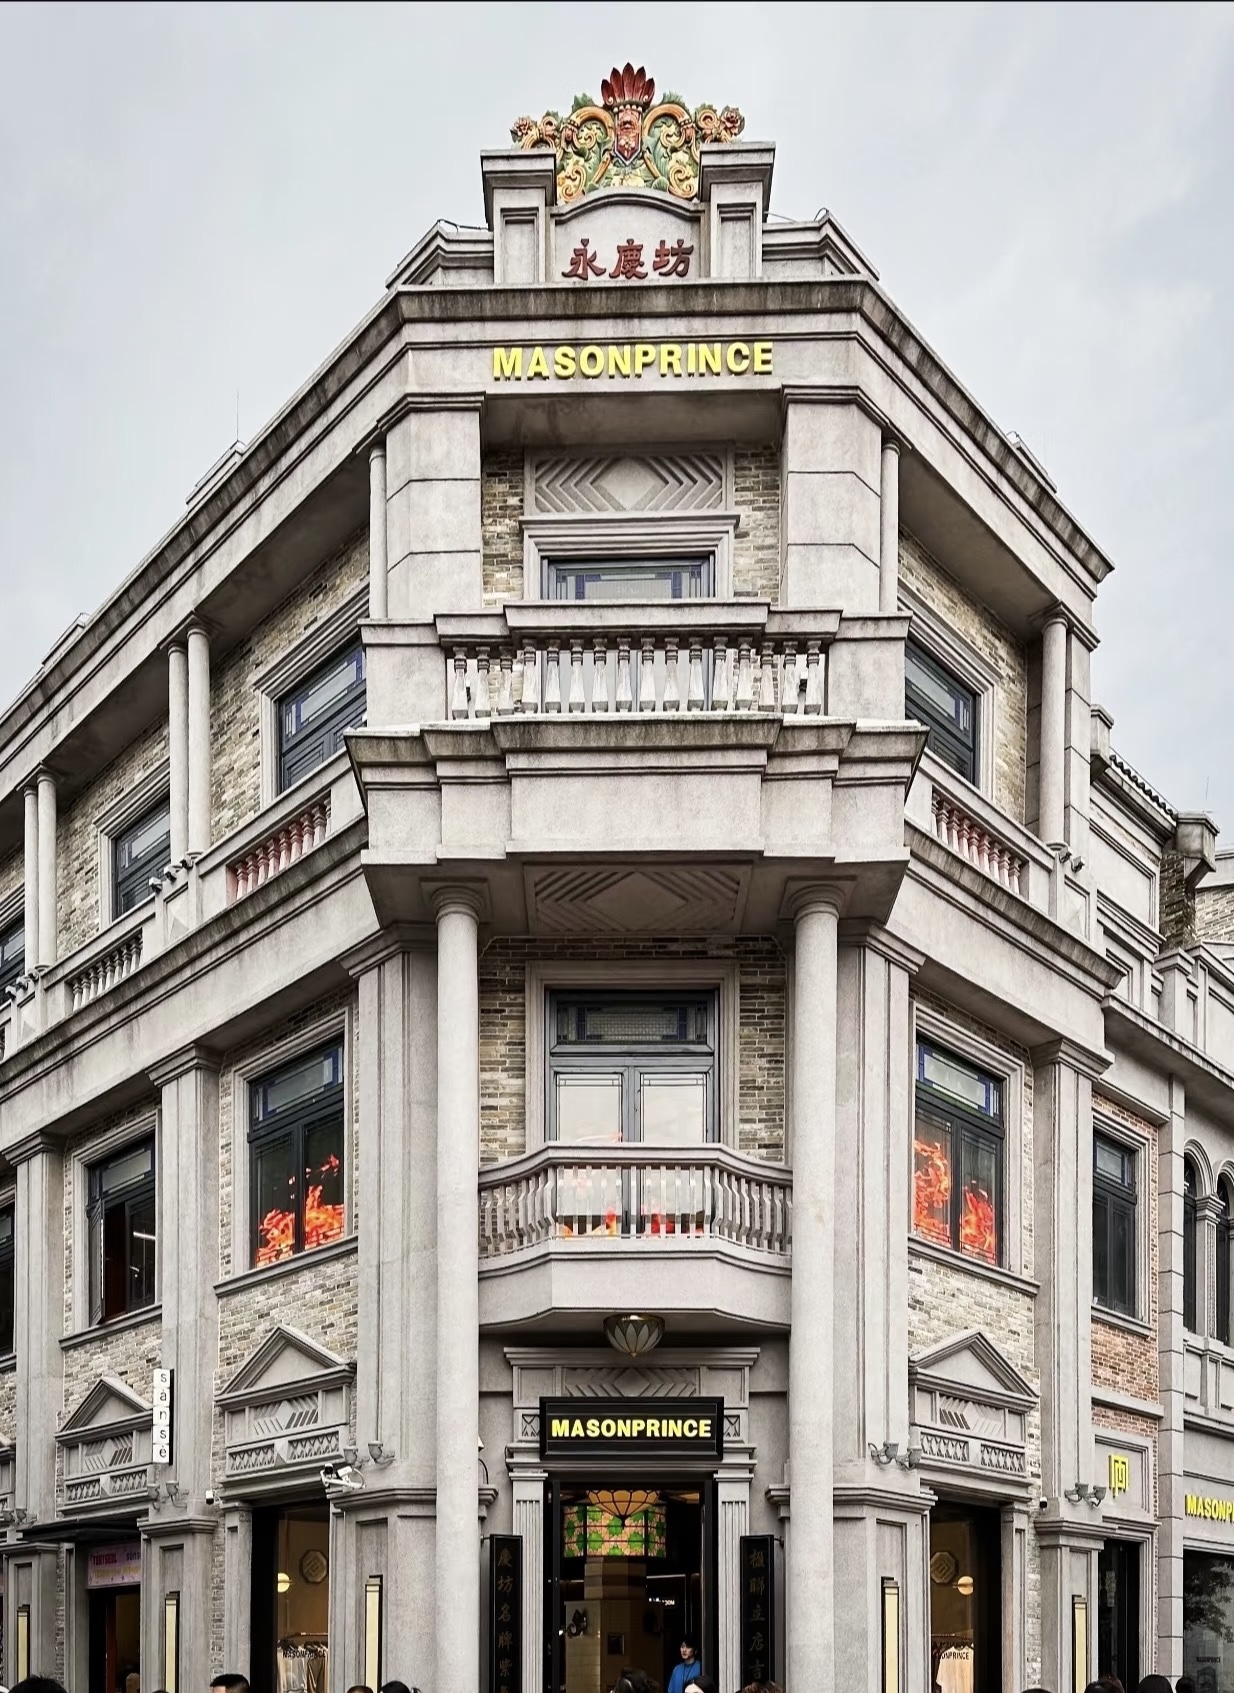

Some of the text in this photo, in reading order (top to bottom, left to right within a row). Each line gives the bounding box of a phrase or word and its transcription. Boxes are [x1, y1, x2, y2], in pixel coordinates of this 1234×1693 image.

[562, 238, 694, 281] 永慶坊
[493, 342, 773, 381] MASONPRINCE
[551, 1419, 712, 1438] MASONPRINCE
[1185, 1494, 1234, 1523] MASONP
